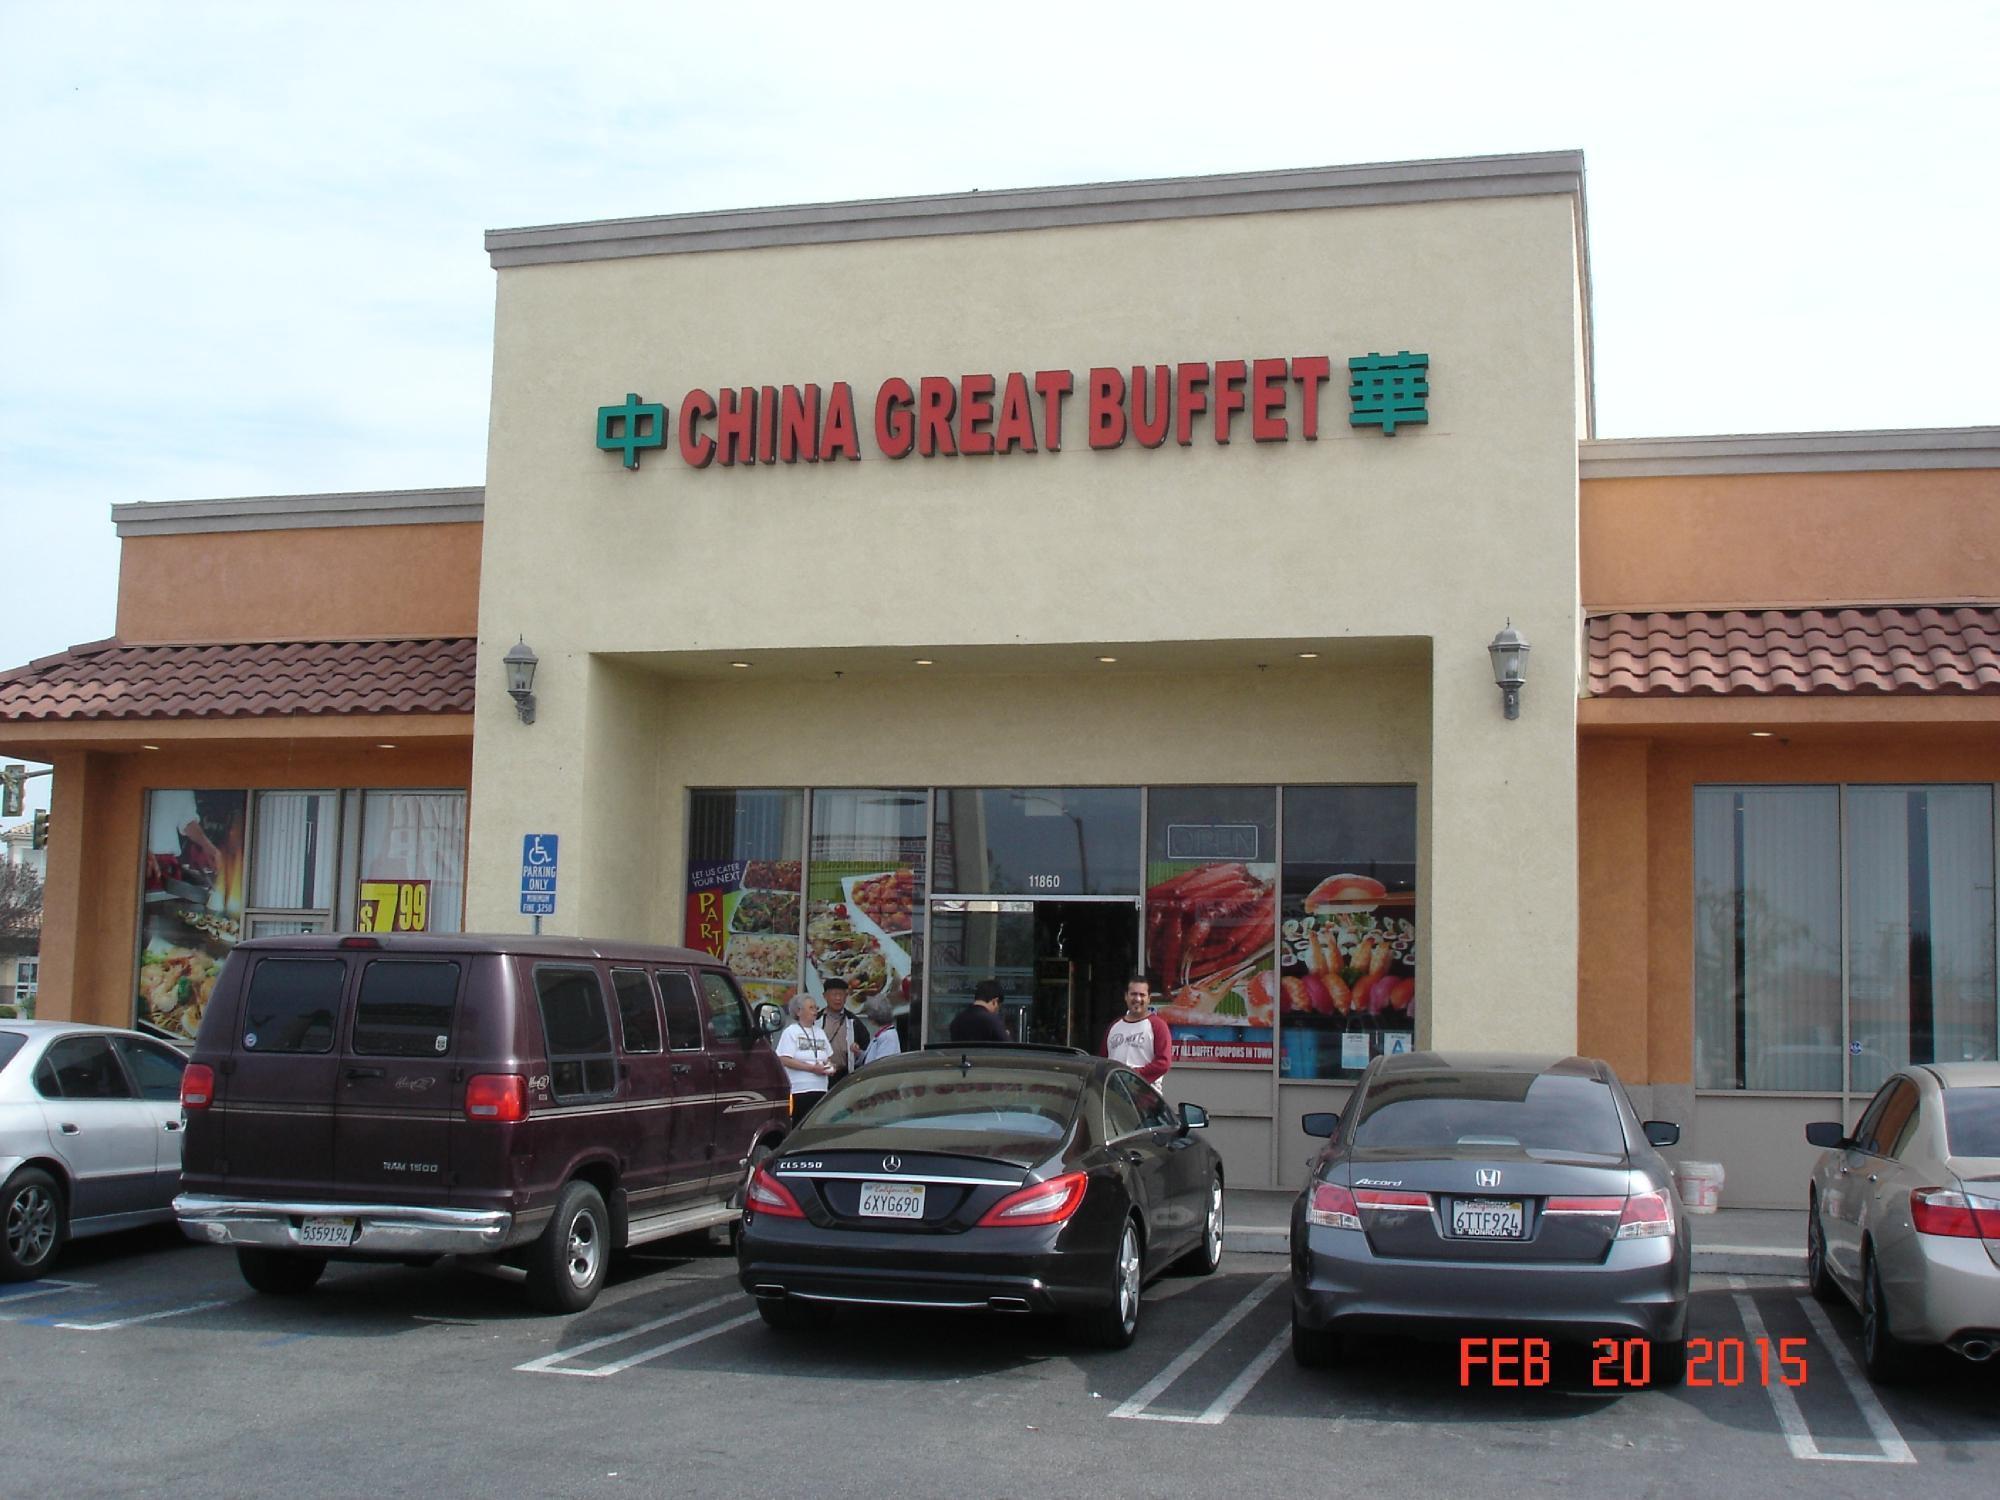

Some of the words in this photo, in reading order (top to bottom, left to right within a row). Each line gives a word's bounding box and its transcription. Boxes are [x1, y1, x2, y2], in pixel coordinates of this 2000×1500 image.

[1348, 350, 1429, 437] 華
[678, 382, 862, 469] CHINA
[875, 370, 1073, 460] GREAT
[1089, 356, 1330, 449] BUFFET
[596, 393, 669, 471] 中
[523, 866, 556, 878] PARKING
[692, 871, 704, 881] LET
[705, 868, 716, 877] US
[716, 862, 740, 875] CATER
[693, 877, 714, 888] YOUR
[716, 870, 741, 885] NEXT
[529, 879, 549, 891] ONLY
[1028, 874, 1060, 888] 11860
[1180, 1045, 1192, 1057] ALL
[1192, 1045, 1214, 1057] BUFFET
[1214, 1046, 1245, 1058] COUPONS
[1245, 1047, 1253, 1058] IN
[1253, 1047, 1273, 1059] TOWN
[1392, 1039, 1405, 1055] A
[383, 1161, 406, 1172] RAM
[409, 1163, 438, 1173] 1500
[1356, 1178, 1402, 1187] Accord
[864, 1195, 919, 1213] 6XYG690
[1456, 1211, 1519, 1231] 6TTF924
